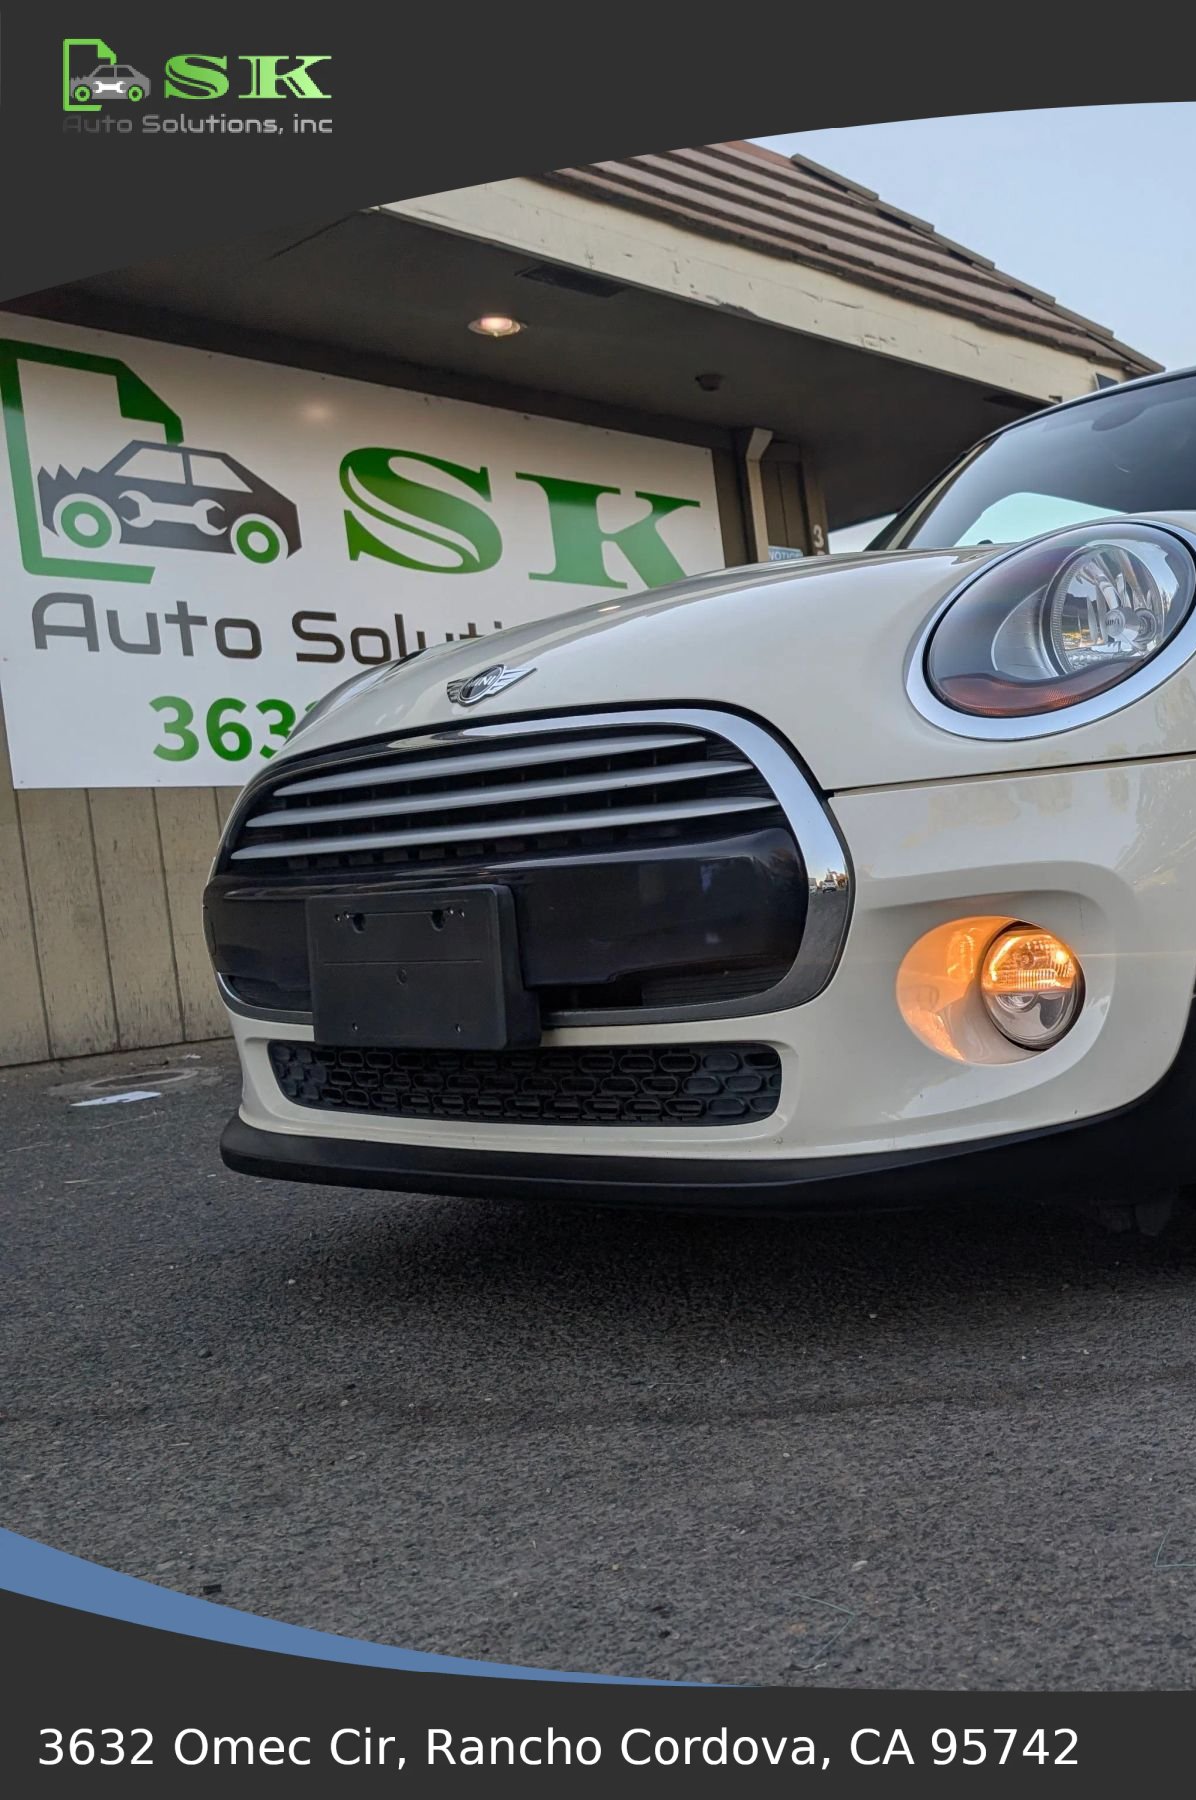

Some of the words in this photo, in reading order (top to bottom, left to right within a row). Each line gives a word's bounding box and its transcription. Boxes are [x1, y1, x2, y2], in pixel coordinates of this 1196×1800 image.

[338, 446, 701, 590] SK
[31, 591, 263, 660] Auto
[468, 675, 497, 687] MINI
[149, 696, 319, 762] 363
